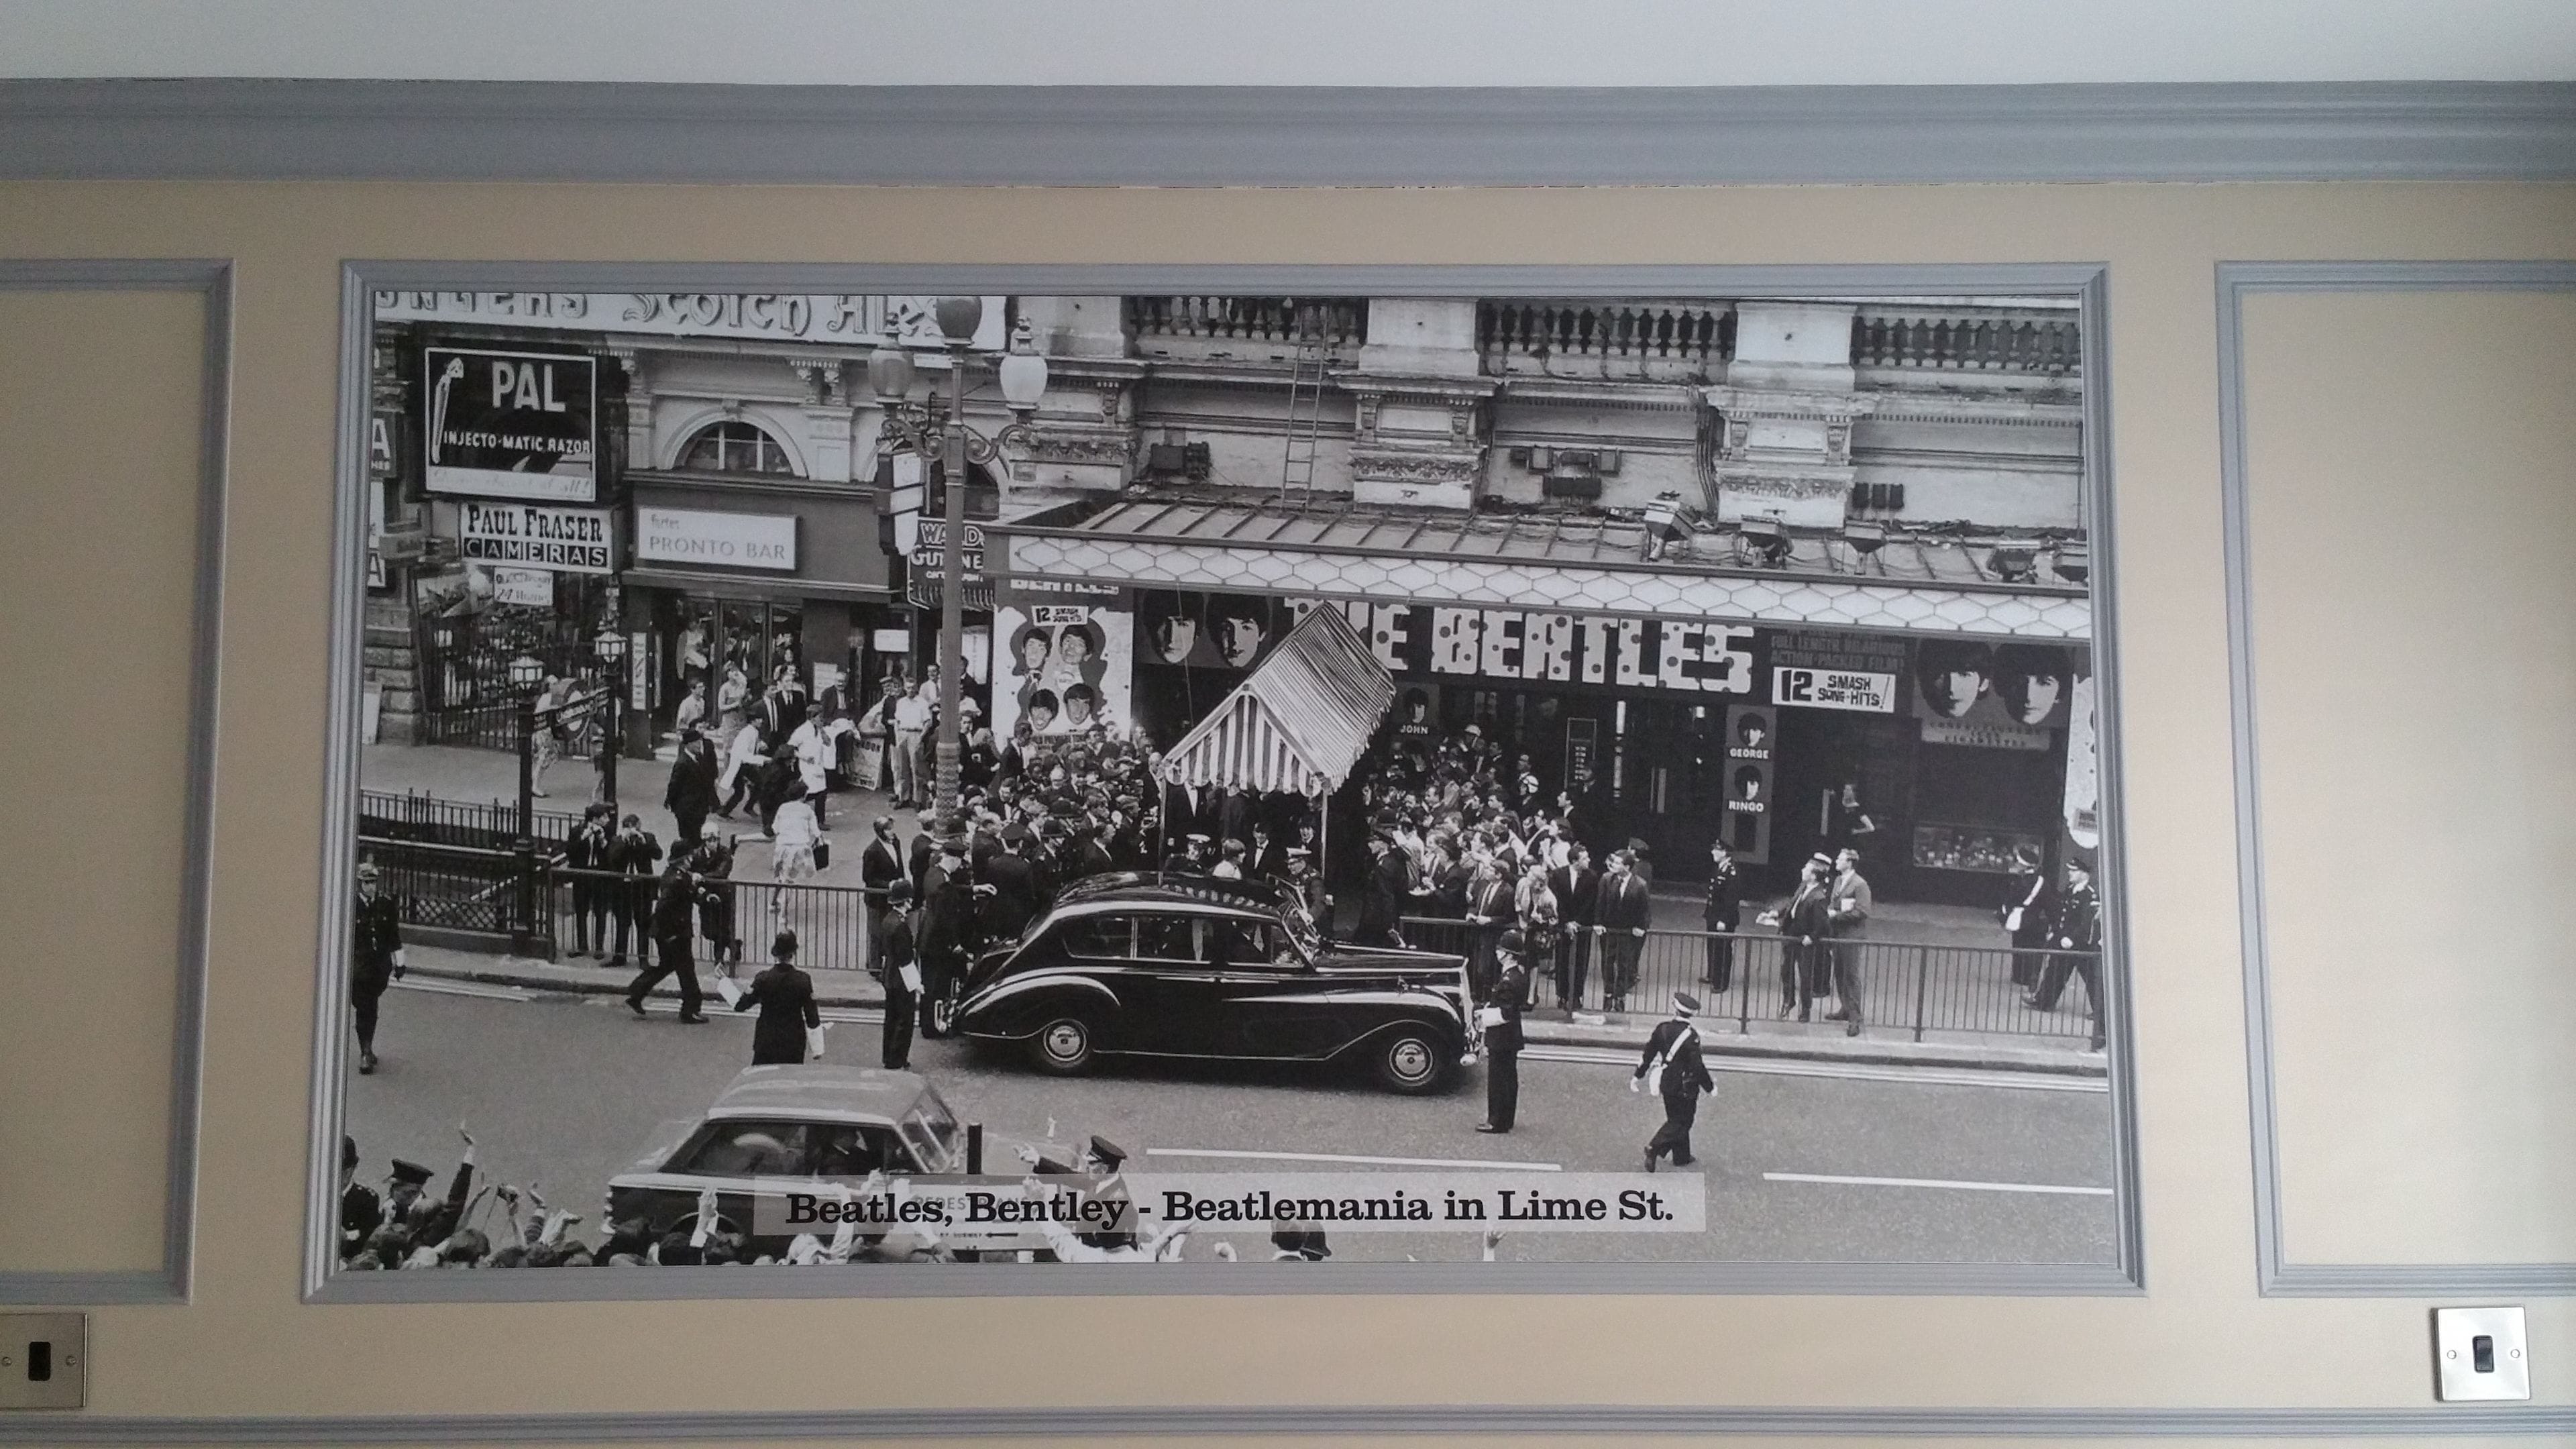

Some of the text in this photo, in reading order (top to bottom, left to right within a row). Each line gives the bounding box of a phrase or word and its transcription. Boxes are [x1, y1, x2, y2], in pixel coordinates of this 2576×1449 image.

[492, 361, 566, 412] PAL
[443, 430, 591, 455] INJECTO-MATIC RAZOR
[468, 503, 603, 543] PAUL FRASER
[466, 538, 606, 568] CAMERAS
[649, 536, 786, 560] PRONTO BAR
[1431, 606, 1755, 694] BEATLES
[1780, 669, 1872, 702] 12 SMASH
[1399, 724, 1429, 735] JOHN
[1729, 747, 1769, 759] GEORGE
[1727, 800, 1764, 812] RINGO
[786, 1192, 953, 1226] Beatles,
[964, 1191, 1127, 1229] Bentley
[1162, 1190, 1433, 1221] Beatlemania
[1444, 1190, 1487, 1220] in
[1497, 1190, 1607, 1220] Lime
[1618, 1189, 1673, 1220] St.
